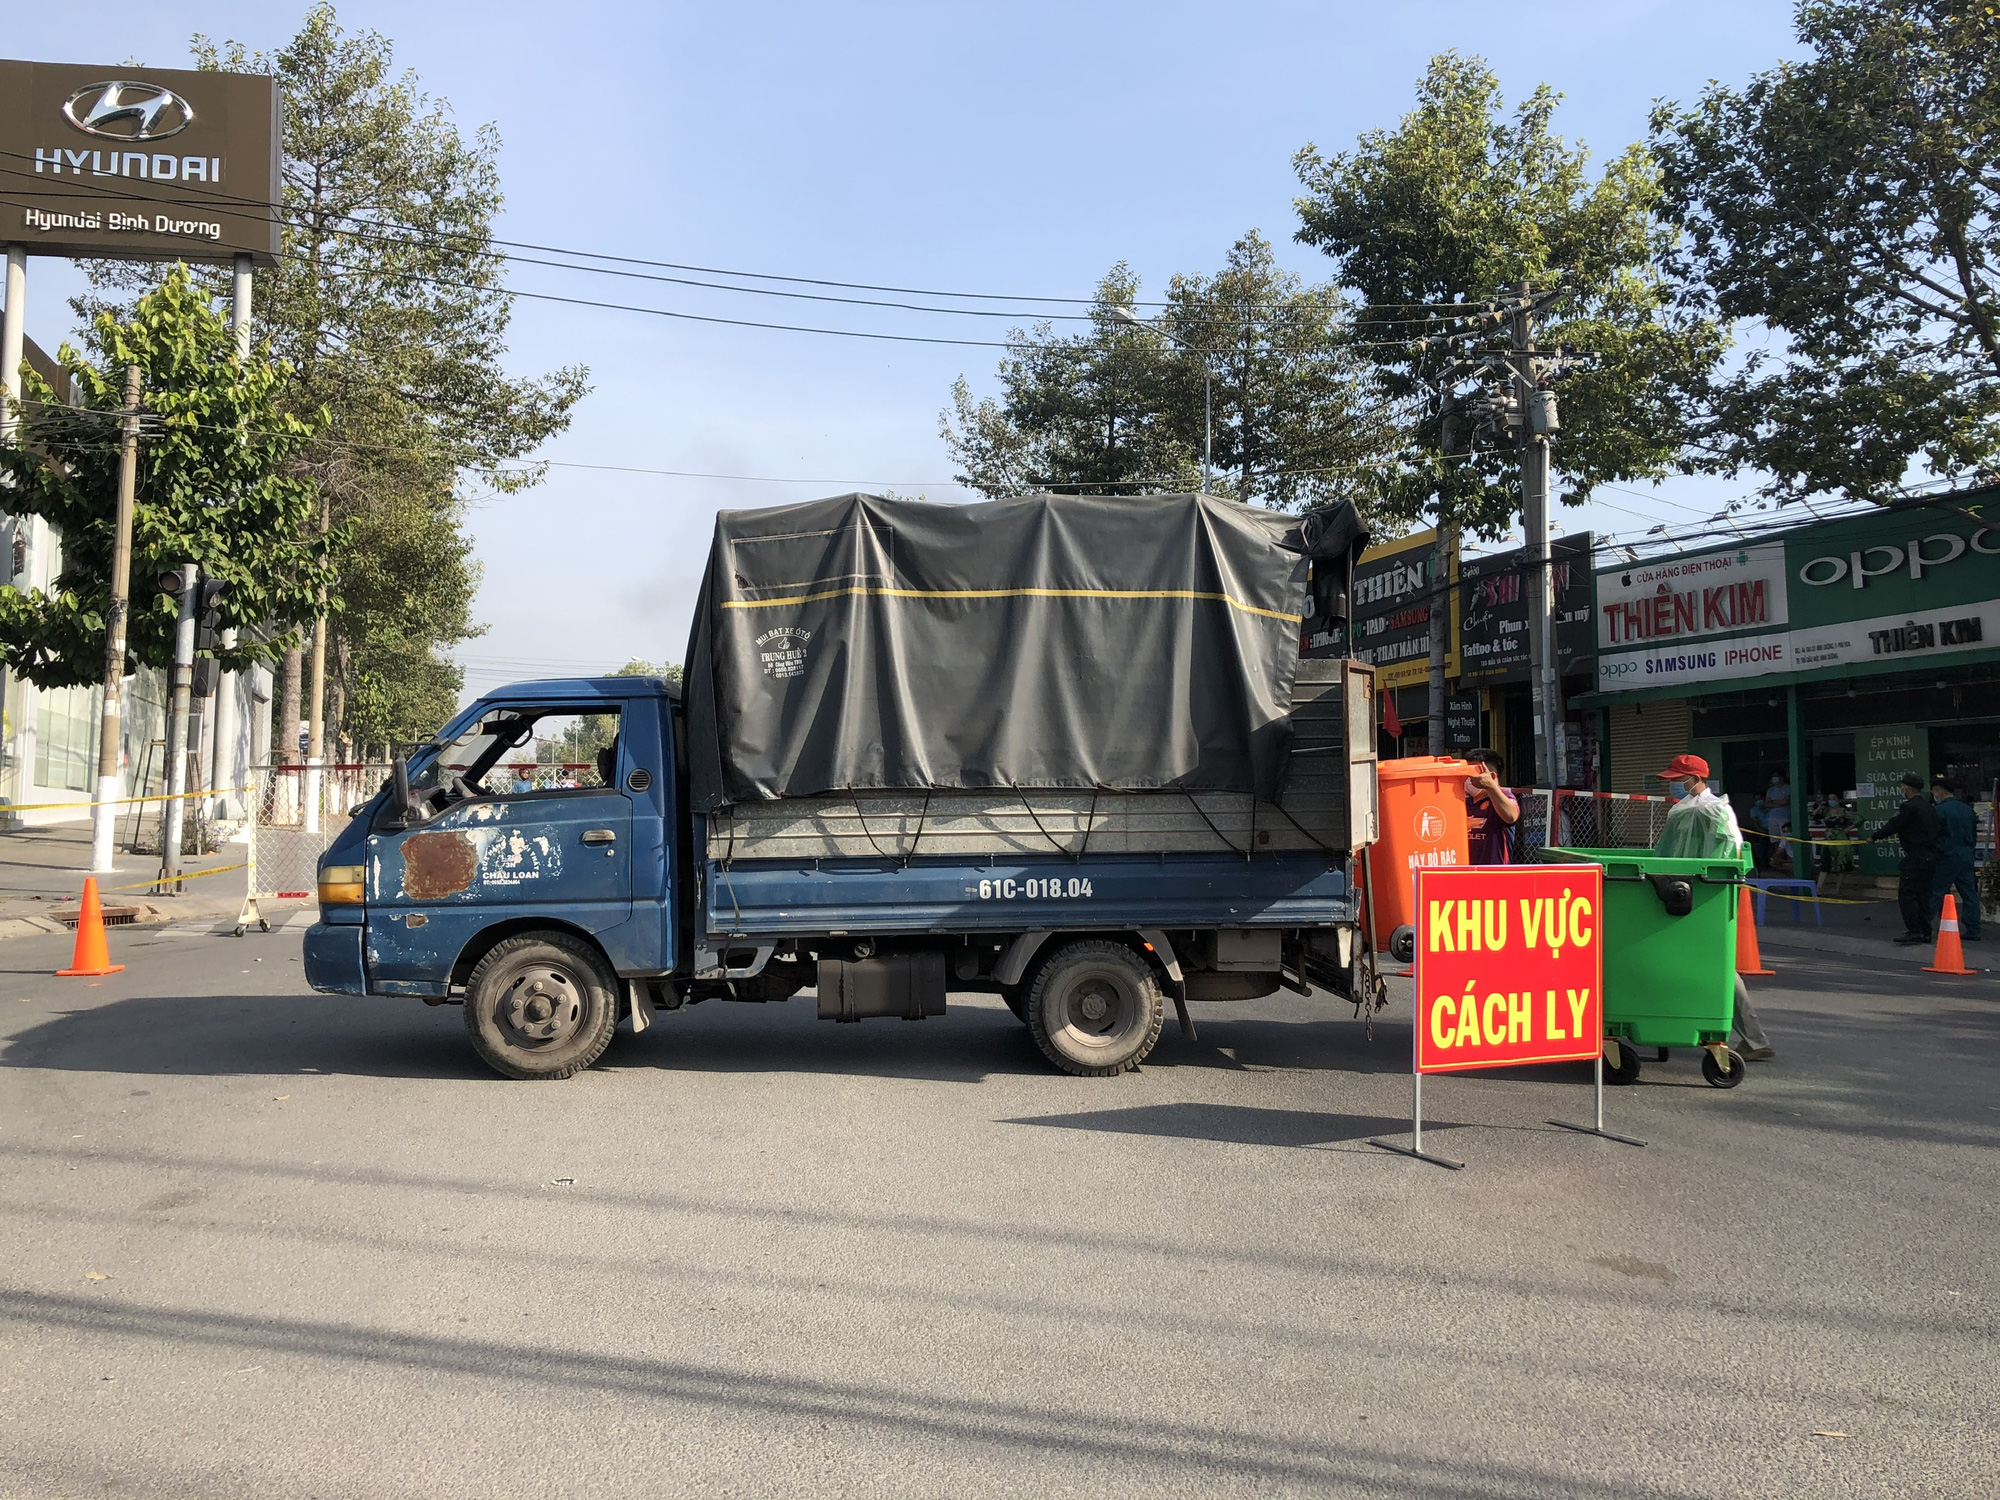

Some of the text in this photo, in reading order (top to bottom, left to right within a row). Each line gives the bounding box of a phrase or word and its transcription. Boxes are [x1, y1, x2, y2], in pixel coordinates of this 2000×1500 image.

[35, 147, 220, 183] HYUNDAI
[108, 211, 149, 231] Bình
[155, 214, 221, 240] Dương
[1636, 557, 1732, 583] CỬA HÀNG ĐIỆN THOẠI
[1354, 560, 1424, 606] THIỆN
[1389, 605, 1428, 630] SAMSUNG
[1603, 582, 1697, 643] THIÊN
[1703, 578, 1768, 629] KIM
[1499, 619, 1522, 635] Phun
[1939, 617, 1982, 646] KIM
[760, 651, 785, 662] TRUNG
[1376, 640, 1400, 662] THAY
[1462, 637, 1518, 657] Tattoo & tóc
[1646, 652, 1716, 675] SAMSUNG
[1724, 644, 1783, 666] IPHONE
[1453, 733, 1470, 742] Tattoo
[1875, 786, 1902, 797] NHAN
[1408, 847, 1456, 869] HÃY BỎ RÁC
[513, 871, 539, 879] LOAN
[979, 877, 1093, 900] 61C-018.04
[1429, 887, 1592, 959] KHU VỰC
[1430, 979, 1590, 1049] CÁCH LY
